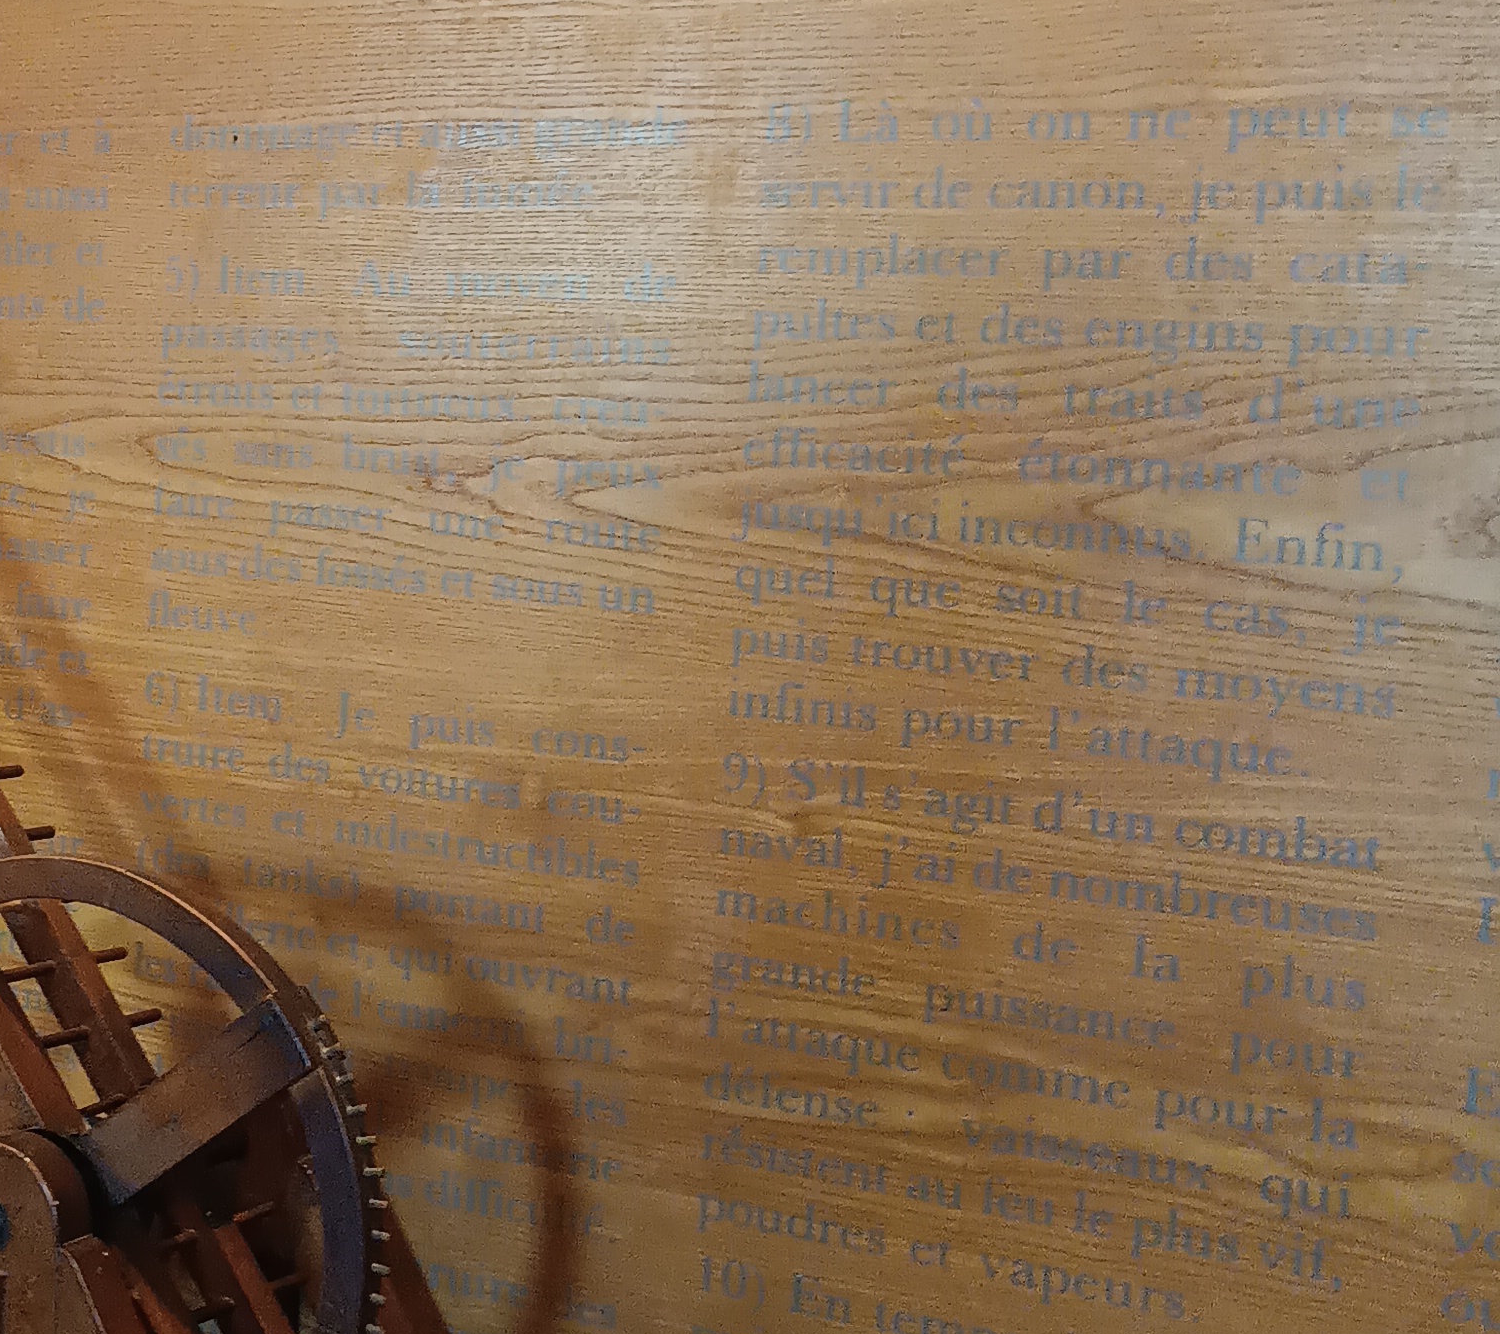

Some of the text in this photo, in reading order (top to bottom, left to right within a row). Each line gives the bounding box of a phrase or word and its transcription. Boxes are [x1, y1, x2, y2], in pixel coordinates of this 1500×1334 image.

[169, 109, 690, 161] dommage et aussi grande
[764, 94, 1449, 155] 8) Là où on ne peut se
[169, 182, 300, 210] terreur
[319, 182, 385, 221] par
[405, 171, 442, 210] la
[759, 168, 897, 210] servir
[913, 165, 971, 210] de
[1180, 166, 1235, 224] je
[1255, 166, 1372, 225] puis
[1395, 166, 1440, 214] le
[164, 255, 200, 303] 5)
[352, 259, 413, 298] Au
[623, 261, 678, 303] de
[757, 232, 1428, 292] remplacer par des cata-
[160, 325, 672, 366] passages souterrains
[753, 298, 1430, 368] pultes et des engins pour
[157, 368, 668, 428] étroits et tortueux, creu-
[747, 359, 1421, 428] lancer des traits d'une
[156, 426, 663, 498] sés sans bruit, je peux
[742, 427, 1410, 503] efficacité étonnante et
[153, 481, 660, 552] faire passer une route
[730, 490, 938, 557] jusqu'ici
[150, 543, 656, 615] sous des fossés et sous un
[735, 556, 835, 607] quel
[869, 577, 960, 618] que
[995, 575, 1082, 619] soit
[1120, 580, 1167, 625] le
[1342, 598, 1403, 657] je
[731, 619, 1397, 719] puis trouver des moyens
[144, 670, 179, 716] 6)
[329, 689, 377, 740] Je
[410, 705, 495, 750] puis
[531, 728, 645, 763] cons-
[729, 676, 877, 732] infinis
[900, 709, 1023, 749] pour
[722, 751, 1381, 870] 9) S'il s'agit d'un combat
[875, 835, 955, 889] j'ai
[973, 848, 1032, 893] de
[1049, 871, 1377, 942] nombreuses
[715, 889, 1367, 1012] machines de la plus
[711, 951, 1365, 1079] grande puissance pour
[703, 996, 1359, 1152] l'attaque comme pour la
[702, 1062, 1350, 1223] défense vaisseaux qui
[695, 1192, 886, 1257] poudres
[907, 1241, 951, 1268] et
[700, 1126, 887, 1194] résistent
[906, 1175, 962, 1210] au
[982, 1178, 1054, 1225] feu
[1071, 1191, 1113, 1238] le
[1131, 1208, 1240, 1265] plus
[701, 1256, 765, 1306] 10)
[788, 1273, 850, 1326] En
